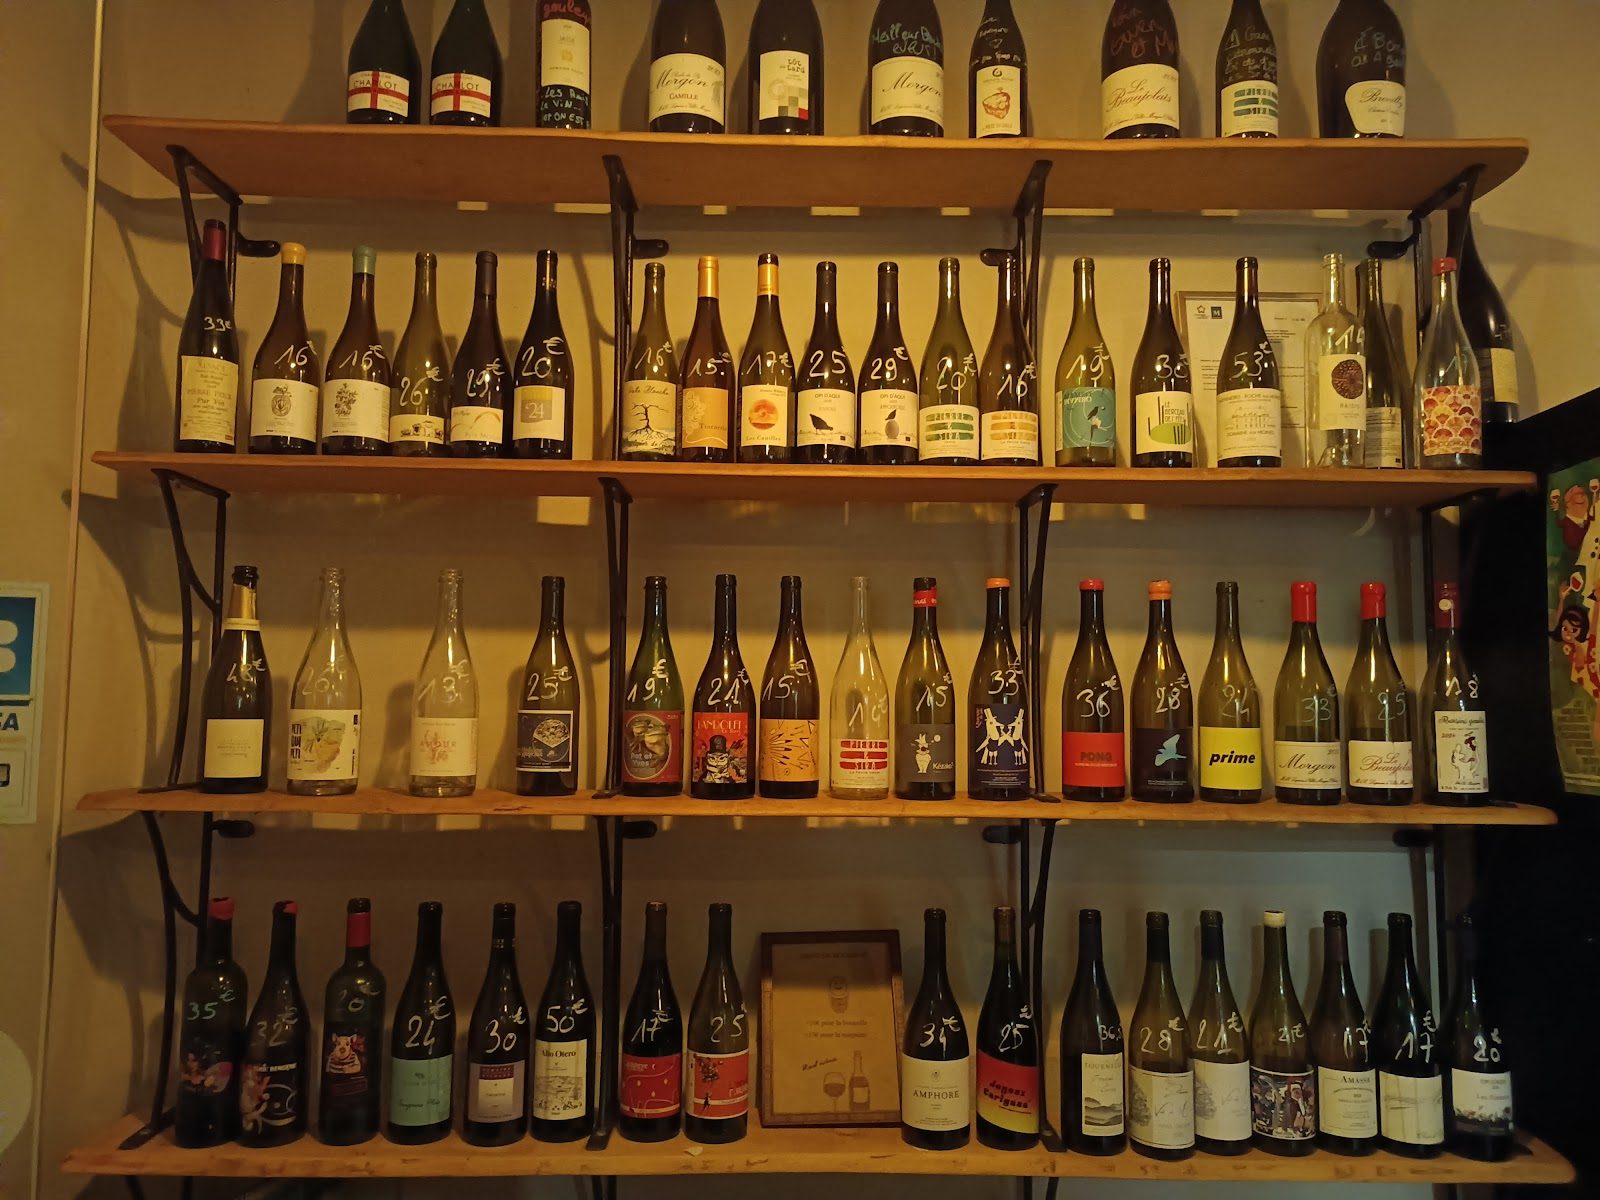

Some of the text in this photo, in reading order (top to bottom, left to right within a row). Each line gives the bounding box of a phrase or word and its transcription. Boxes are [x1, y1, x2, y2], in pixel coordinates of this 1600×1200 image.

[656, 68, 707, 90] Morgon
[669, 92, 699, 100] CAMILLE
[882, 71, 942, 96] Morgon
[203, 315, 233, 332] 33€
[338, 344, 386, 371] 16€
[521, 336, 566, 379] 20€
[745, 351, 792, 376] 17€
[870, 346, 909, 382] 29€
[399, 366, 444, 408] 26€
[527, 666, 573, 702] 25€
[627, 658, 667, 703] 19€
[707, 668, 749, 706] 21€
[915, 671, 953, 712] 15€
[1076, 674, 1120, 718] 36€
[1155, 672, 1191, 714] 28€
[1300, 683, 1338, 722] 33€
[1209, 749, 1256, 767] prime
[1279, 753, 1336, 775] Morgon
[187, 989, 236, 1021] 35€
[544, 997, 589, 1034] 50€
[405, 995, 451, 1056] 24€
[485, 1005, 527, 1054] 30€
[630, 1008, 674, 1044] 17€
[919, 1015, 961, 1052] 34€
[1140, 1016, 1185, 1057] 28€
[1395, 1009, 1437, 1064] 17€
[912, 1088, 960, 1099] AMPHORE
